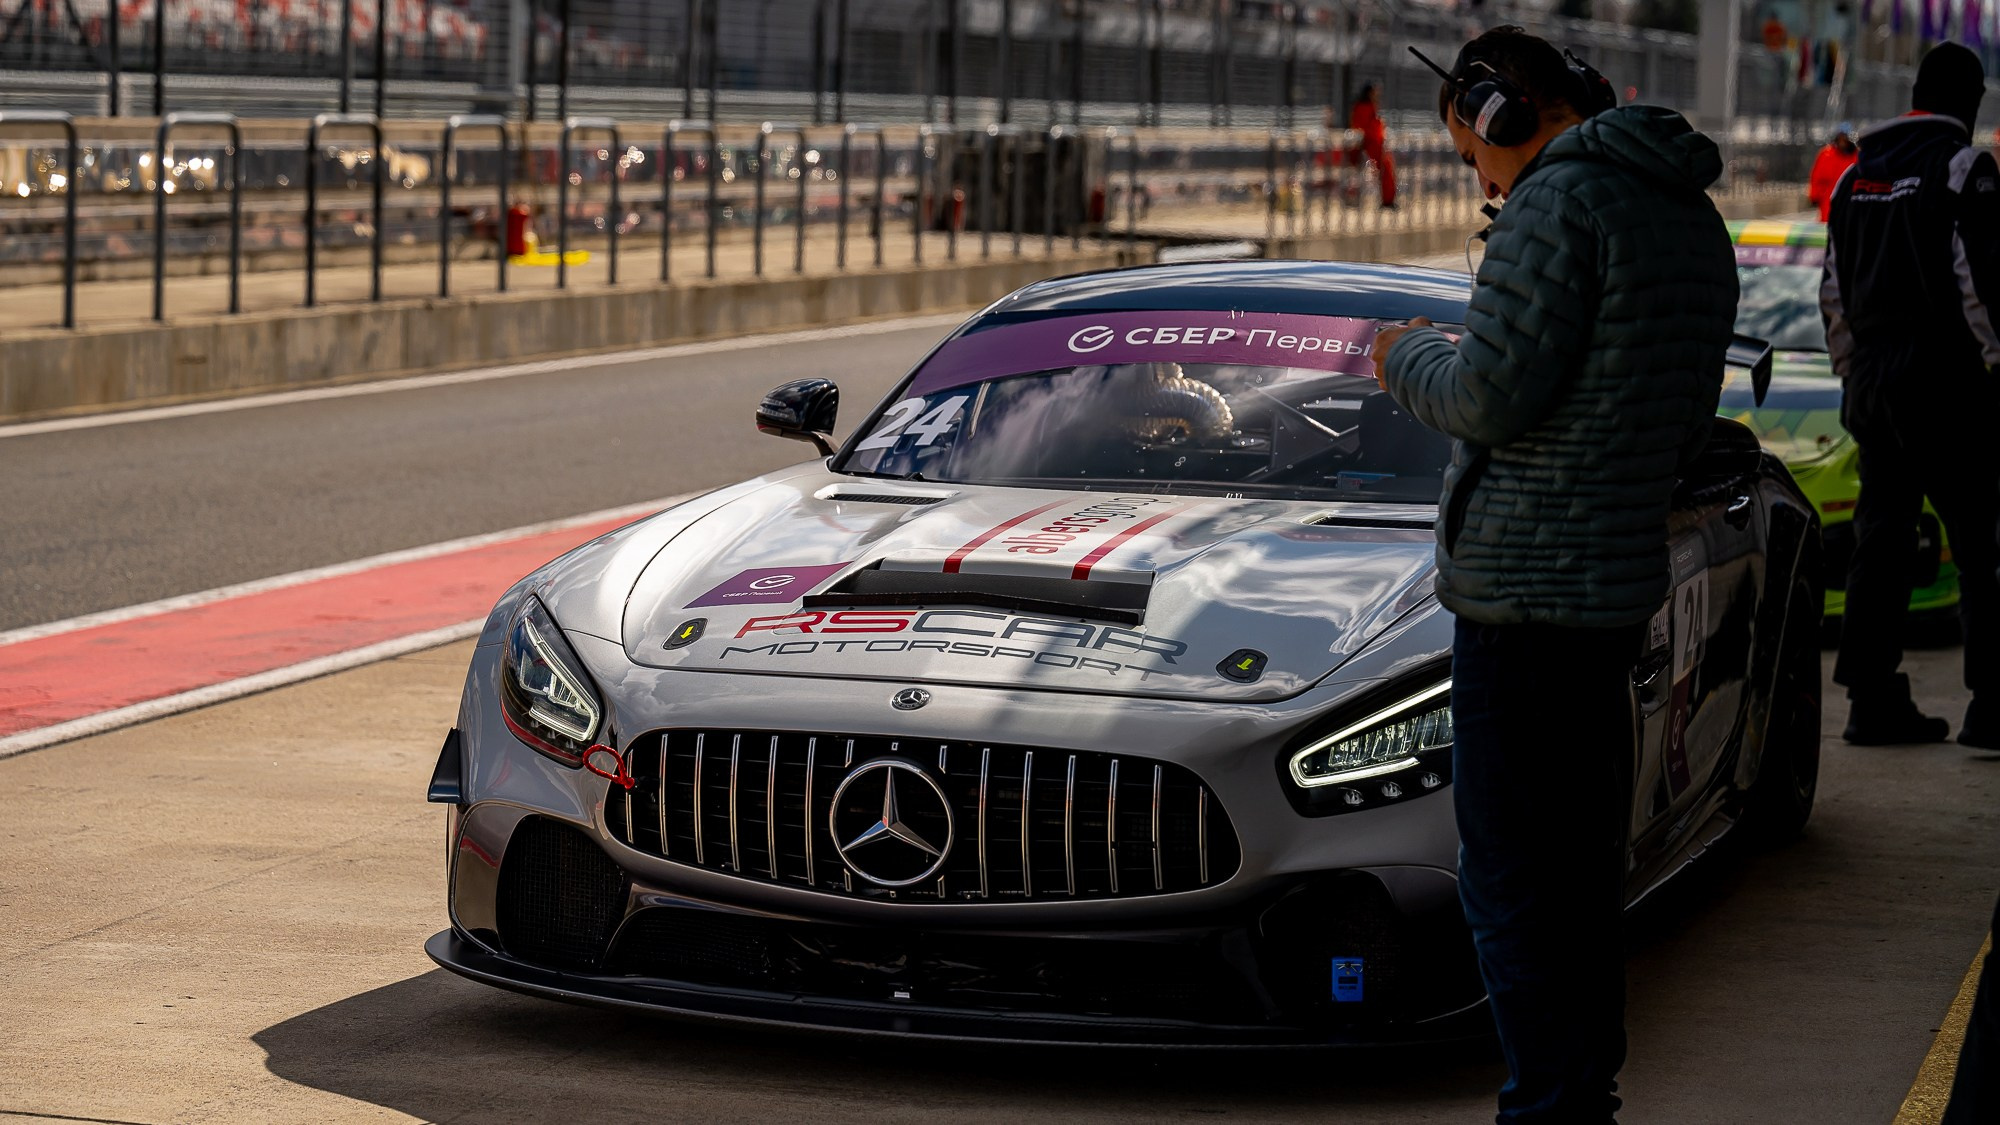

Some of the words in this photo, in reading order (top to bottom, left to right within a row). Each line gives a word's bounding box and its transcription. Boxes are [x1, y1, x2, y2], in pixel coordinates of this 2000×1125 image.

[1125, 327, 1236, 345] СБЕР
[1245, 329, 1370, 356] Первы
[854, 395, 970, 452] 24
[1001, 496, 1172, 555] albersgroup
[1682, 579, 1704, 673] 24
[719, 639, 1173, 682] MOTORSPORT
